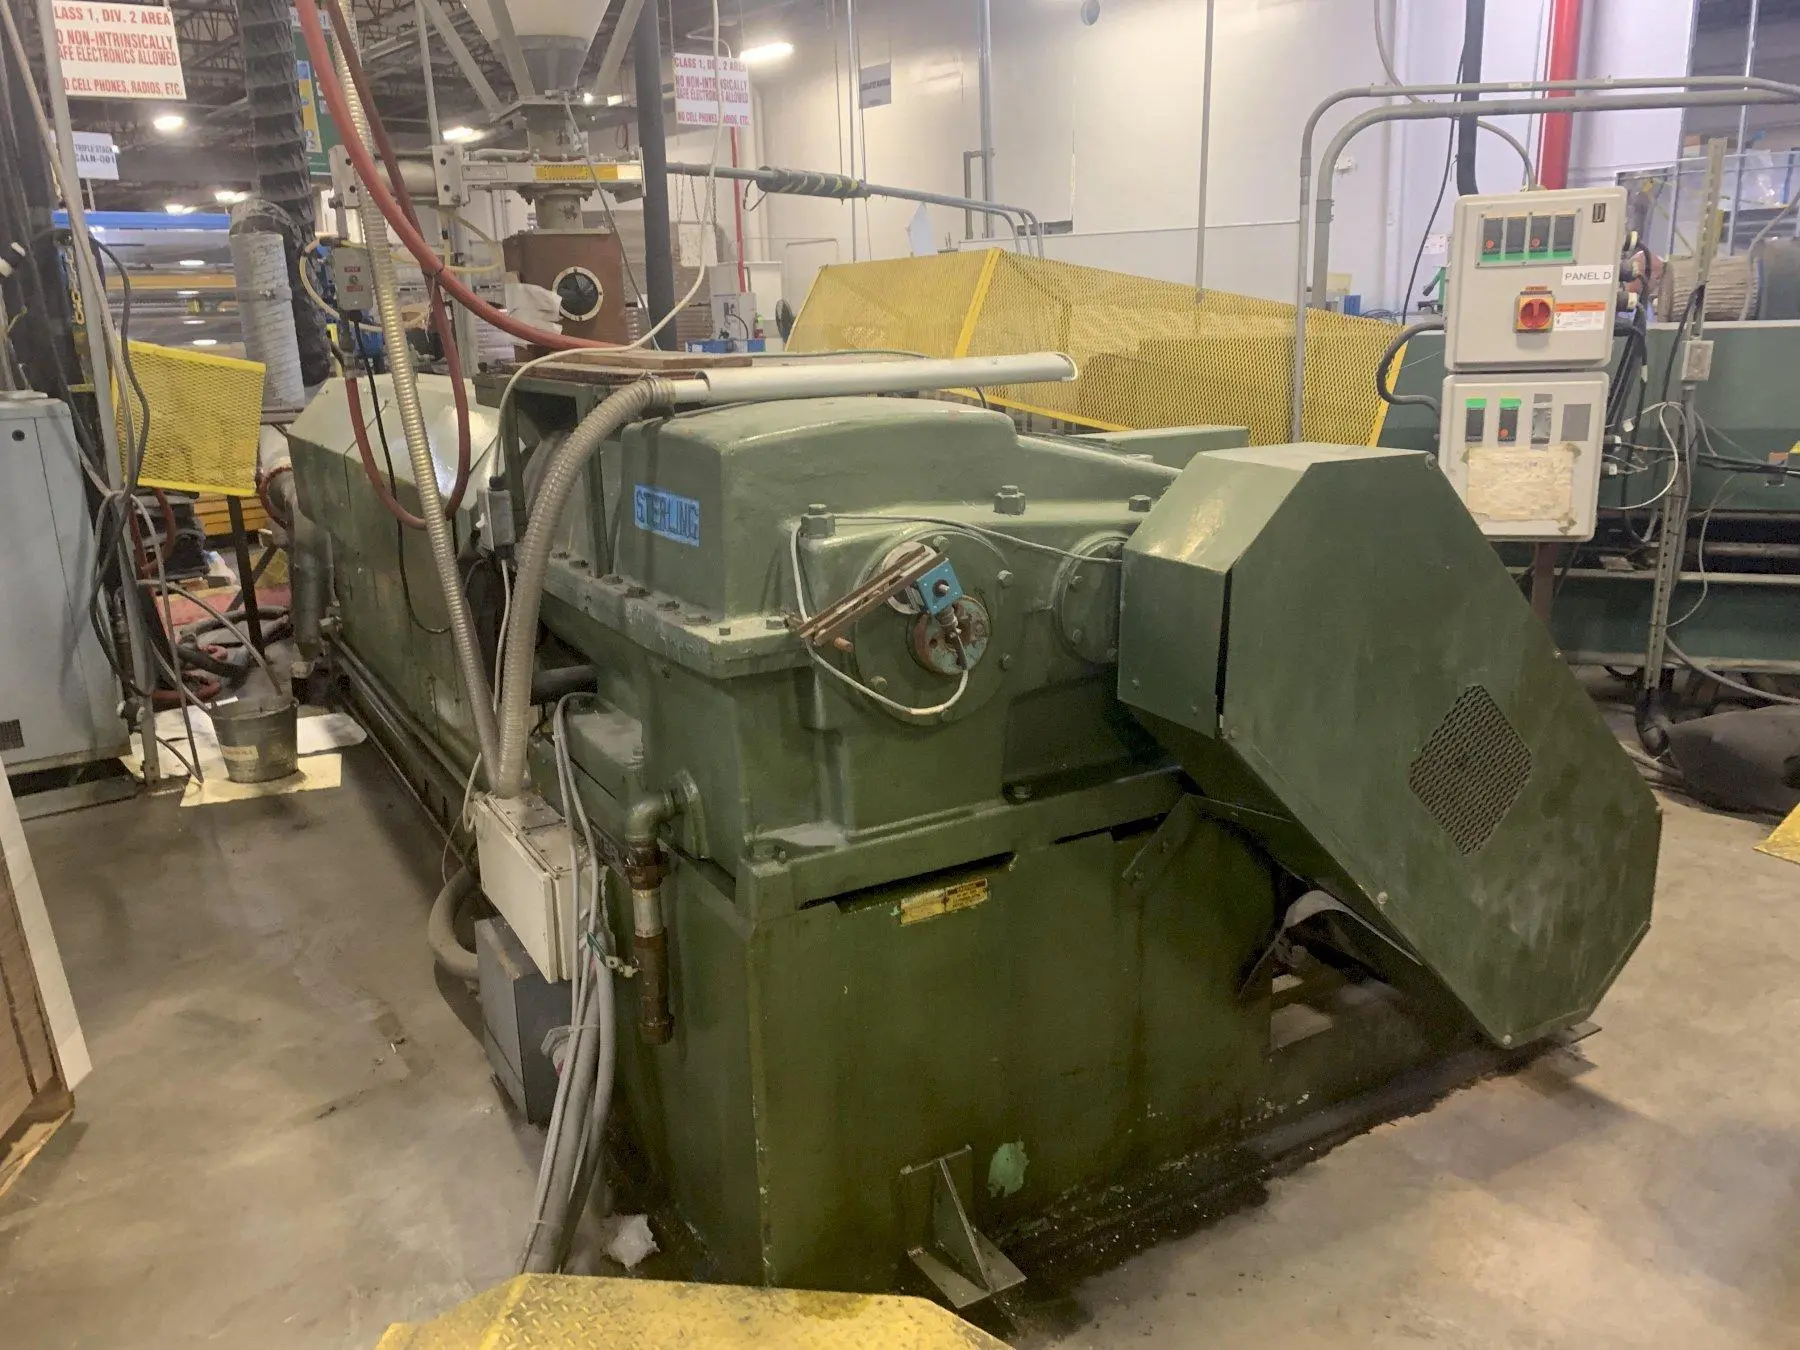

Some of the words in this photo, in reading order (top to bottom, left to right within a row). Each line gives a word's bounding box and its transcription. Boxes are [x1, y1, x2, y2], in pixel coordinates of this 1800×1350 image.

[54, 6, 83, 20] LASS
[130, 10, 137, 24] 2
[141, 11, 171, 26] AREA
[67, 29, 173, 50] NON-INTRINSICALLY
[76, 46, 136, 64] ELECTRONICS
[138, 50, 177, 66] ALLOWED
[72, 77, 92, 91] CELL
[1565, 271, 1599, 281] PANEL
[1603, 271, 1611, 280] D
[636, 489, 699, 540] STERLING
